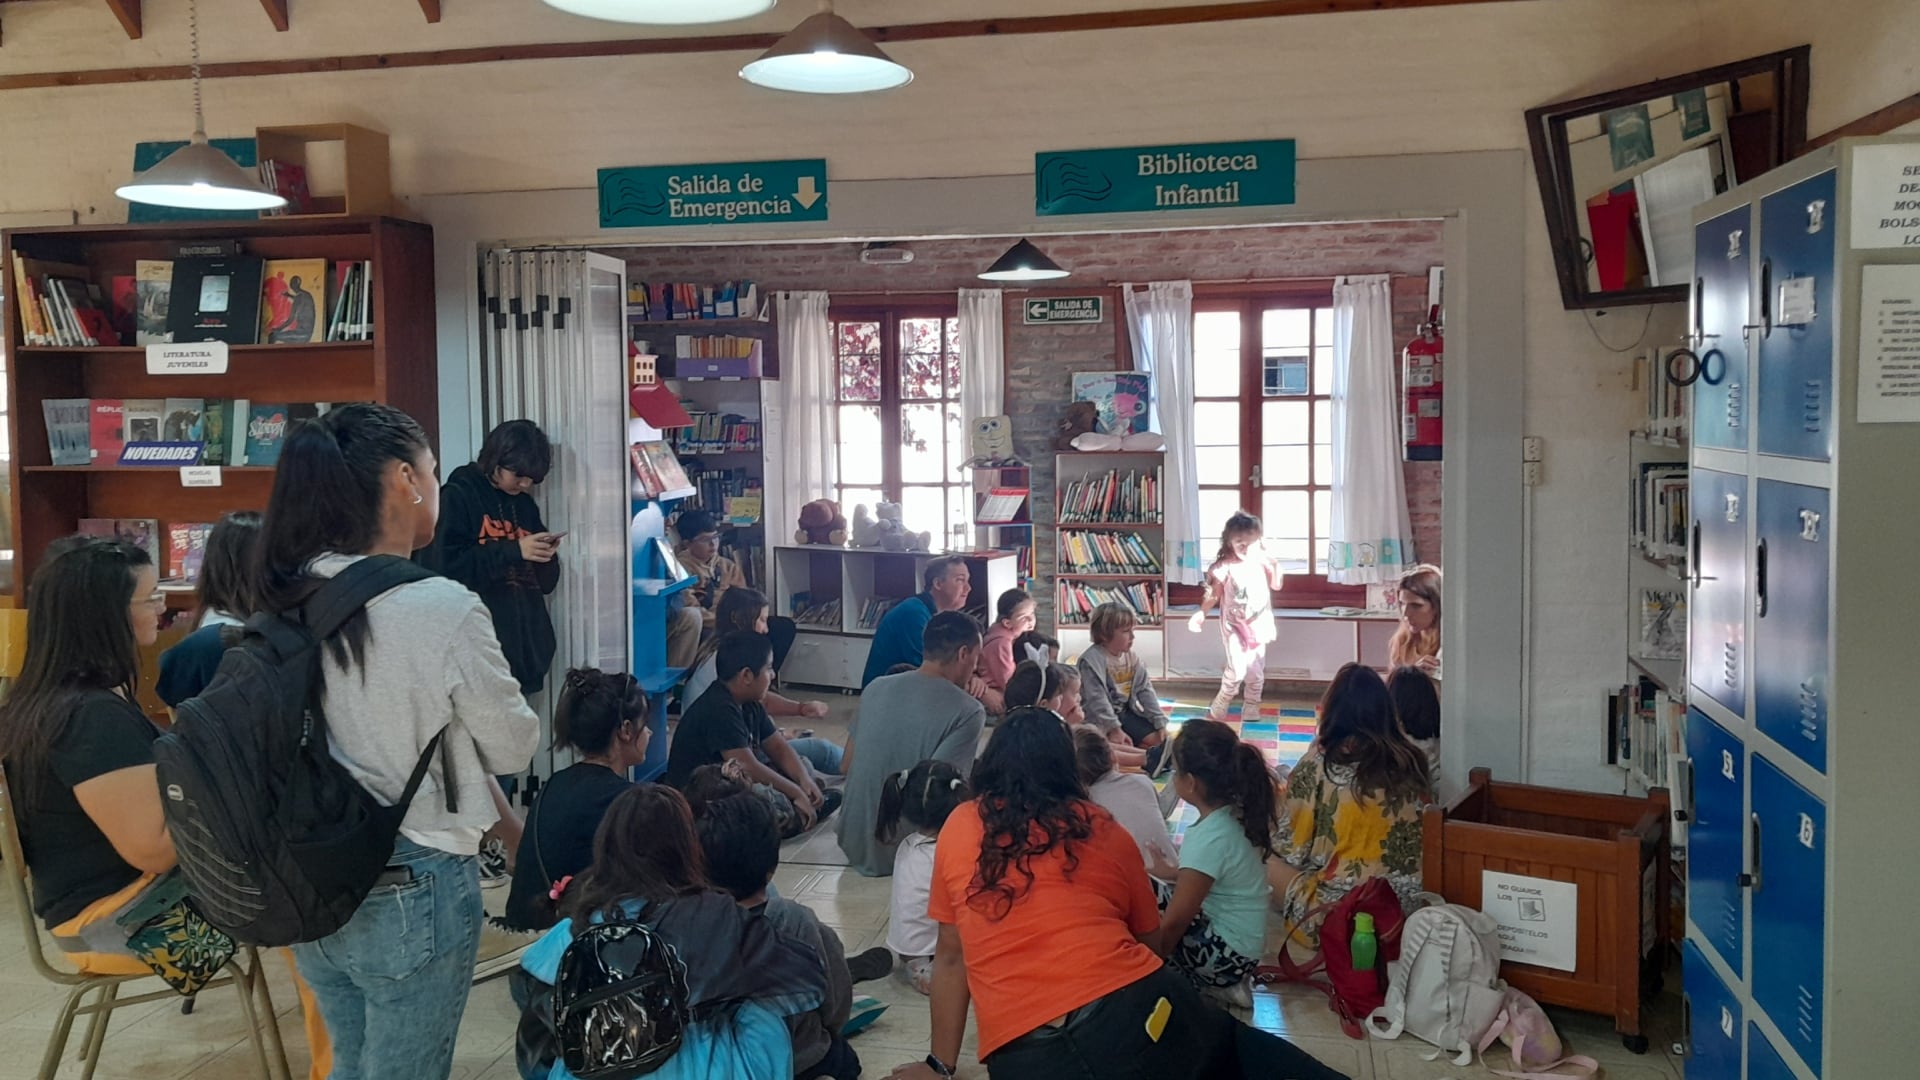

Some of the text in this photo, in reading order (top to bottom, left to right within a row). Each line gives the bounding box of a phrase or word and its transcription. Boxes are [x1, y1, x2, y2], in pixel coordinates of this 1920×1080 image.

[1137, 153, 1258, 176] Biblioteca
[668, 174, 763, 195] Salida de
[1898, 183, 1920, 193] DE
[1155, 182, 1240, 206] Infantil
[669, 195, 792, 220] Emergencia
[1879, 217, 1920, 229] BOLS
[1054, 300, 1093, 310] SALIDA DE
[1050, 309, 1098, 319] EMERGENCIA
[163, 351, 212, 359] LITERATURA
[166, 361, 209, 369] JUVENILES
[122, 446, 199, 460] NOVEDADES
[1510, 885, 1542, 896] GUARDE
[1496, 893, 1512, 901] LOS
